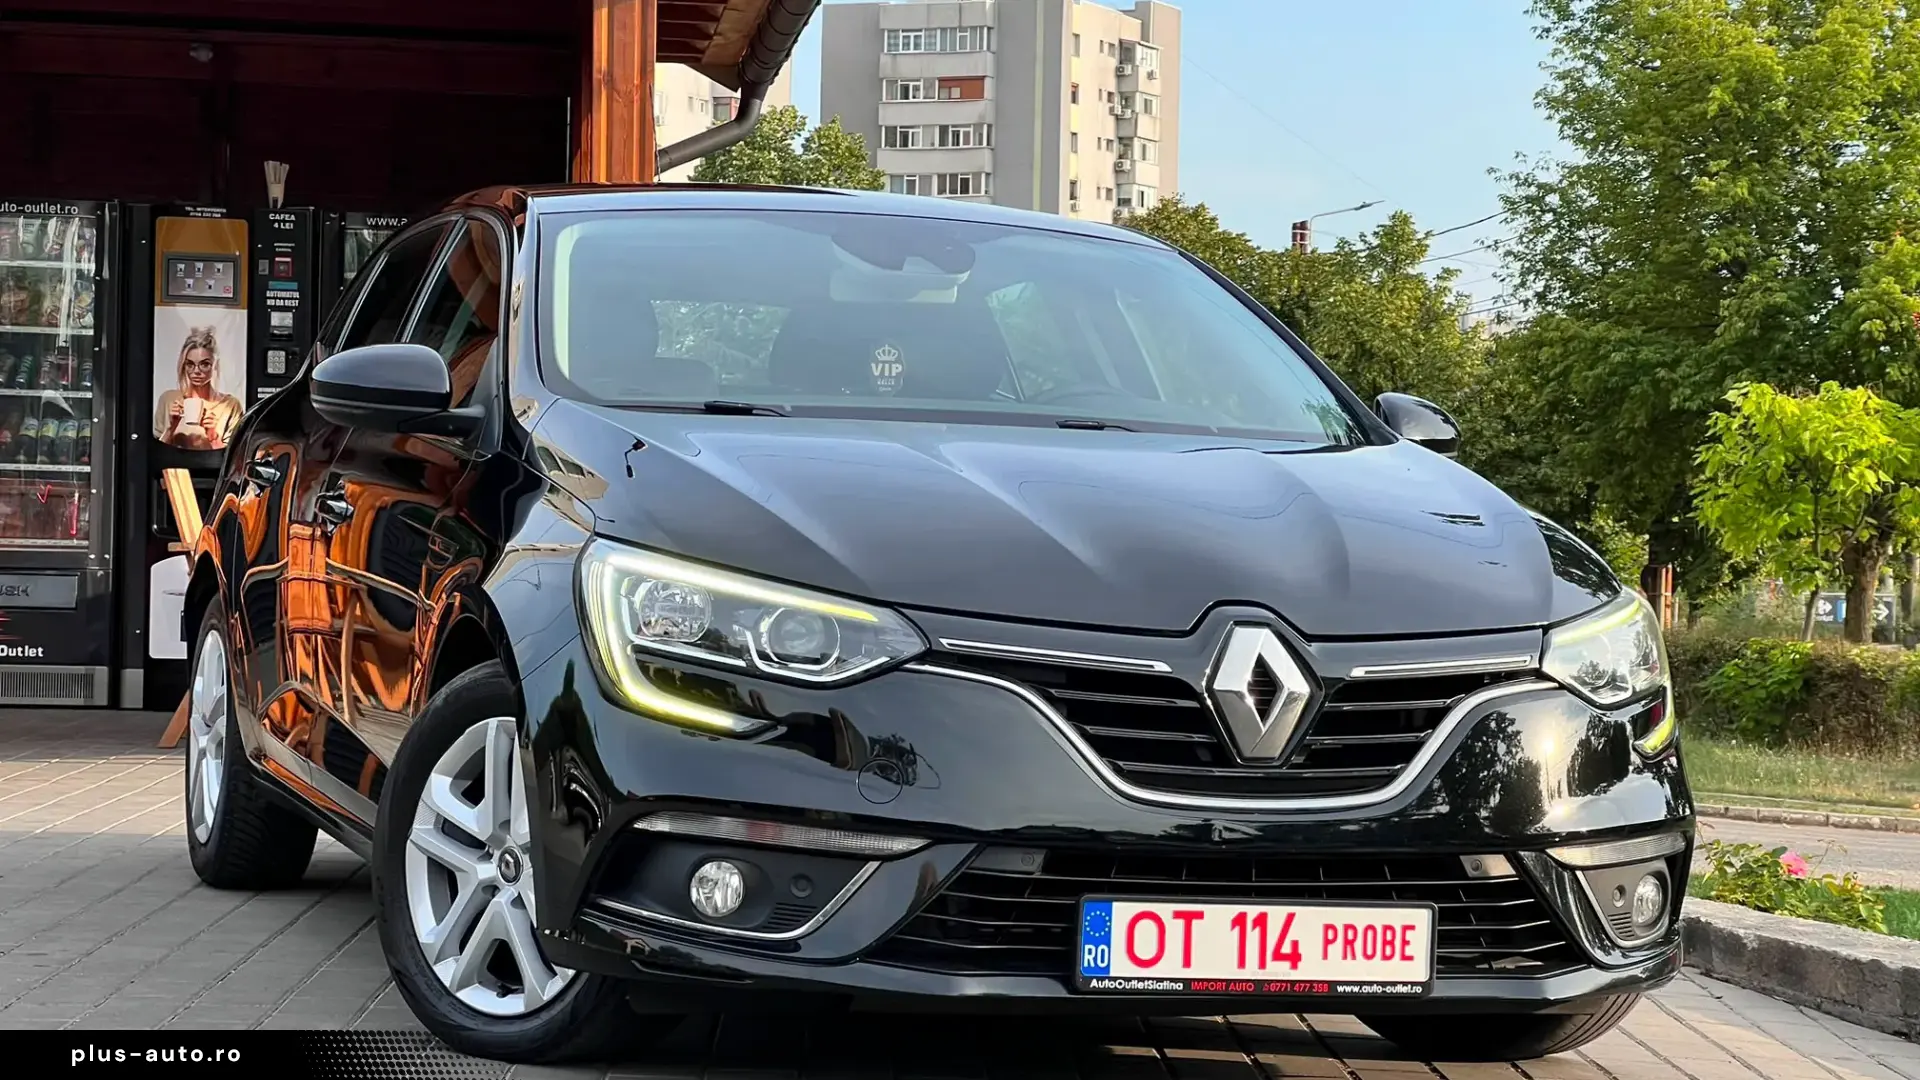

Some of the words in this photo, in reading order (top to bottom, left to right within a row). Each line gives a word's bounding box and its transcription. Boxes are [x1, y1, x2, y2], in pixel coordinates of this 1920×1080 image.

[269, 213, 296, 221] CAFEA
[871, 362, 902, 377] VIP
[1126, 910, 1205, 969] OT
[1231, 911, 1302, 971] 114
[1322, 923, 1417, 962] PROBE
[1083, 944, 1109, 968] RO
[1090, 978, 1184, 991] AutoOutletSlatina
[1191, 980, 1226, 991] IMPORT
[1228, 981, 1255, 992] AUTO
[1270, 983, 1291, 992] 0771
[1293, 983, 1310, 993] 477
[1336, 984, 1423, 995] www.auto-outlet.ro
